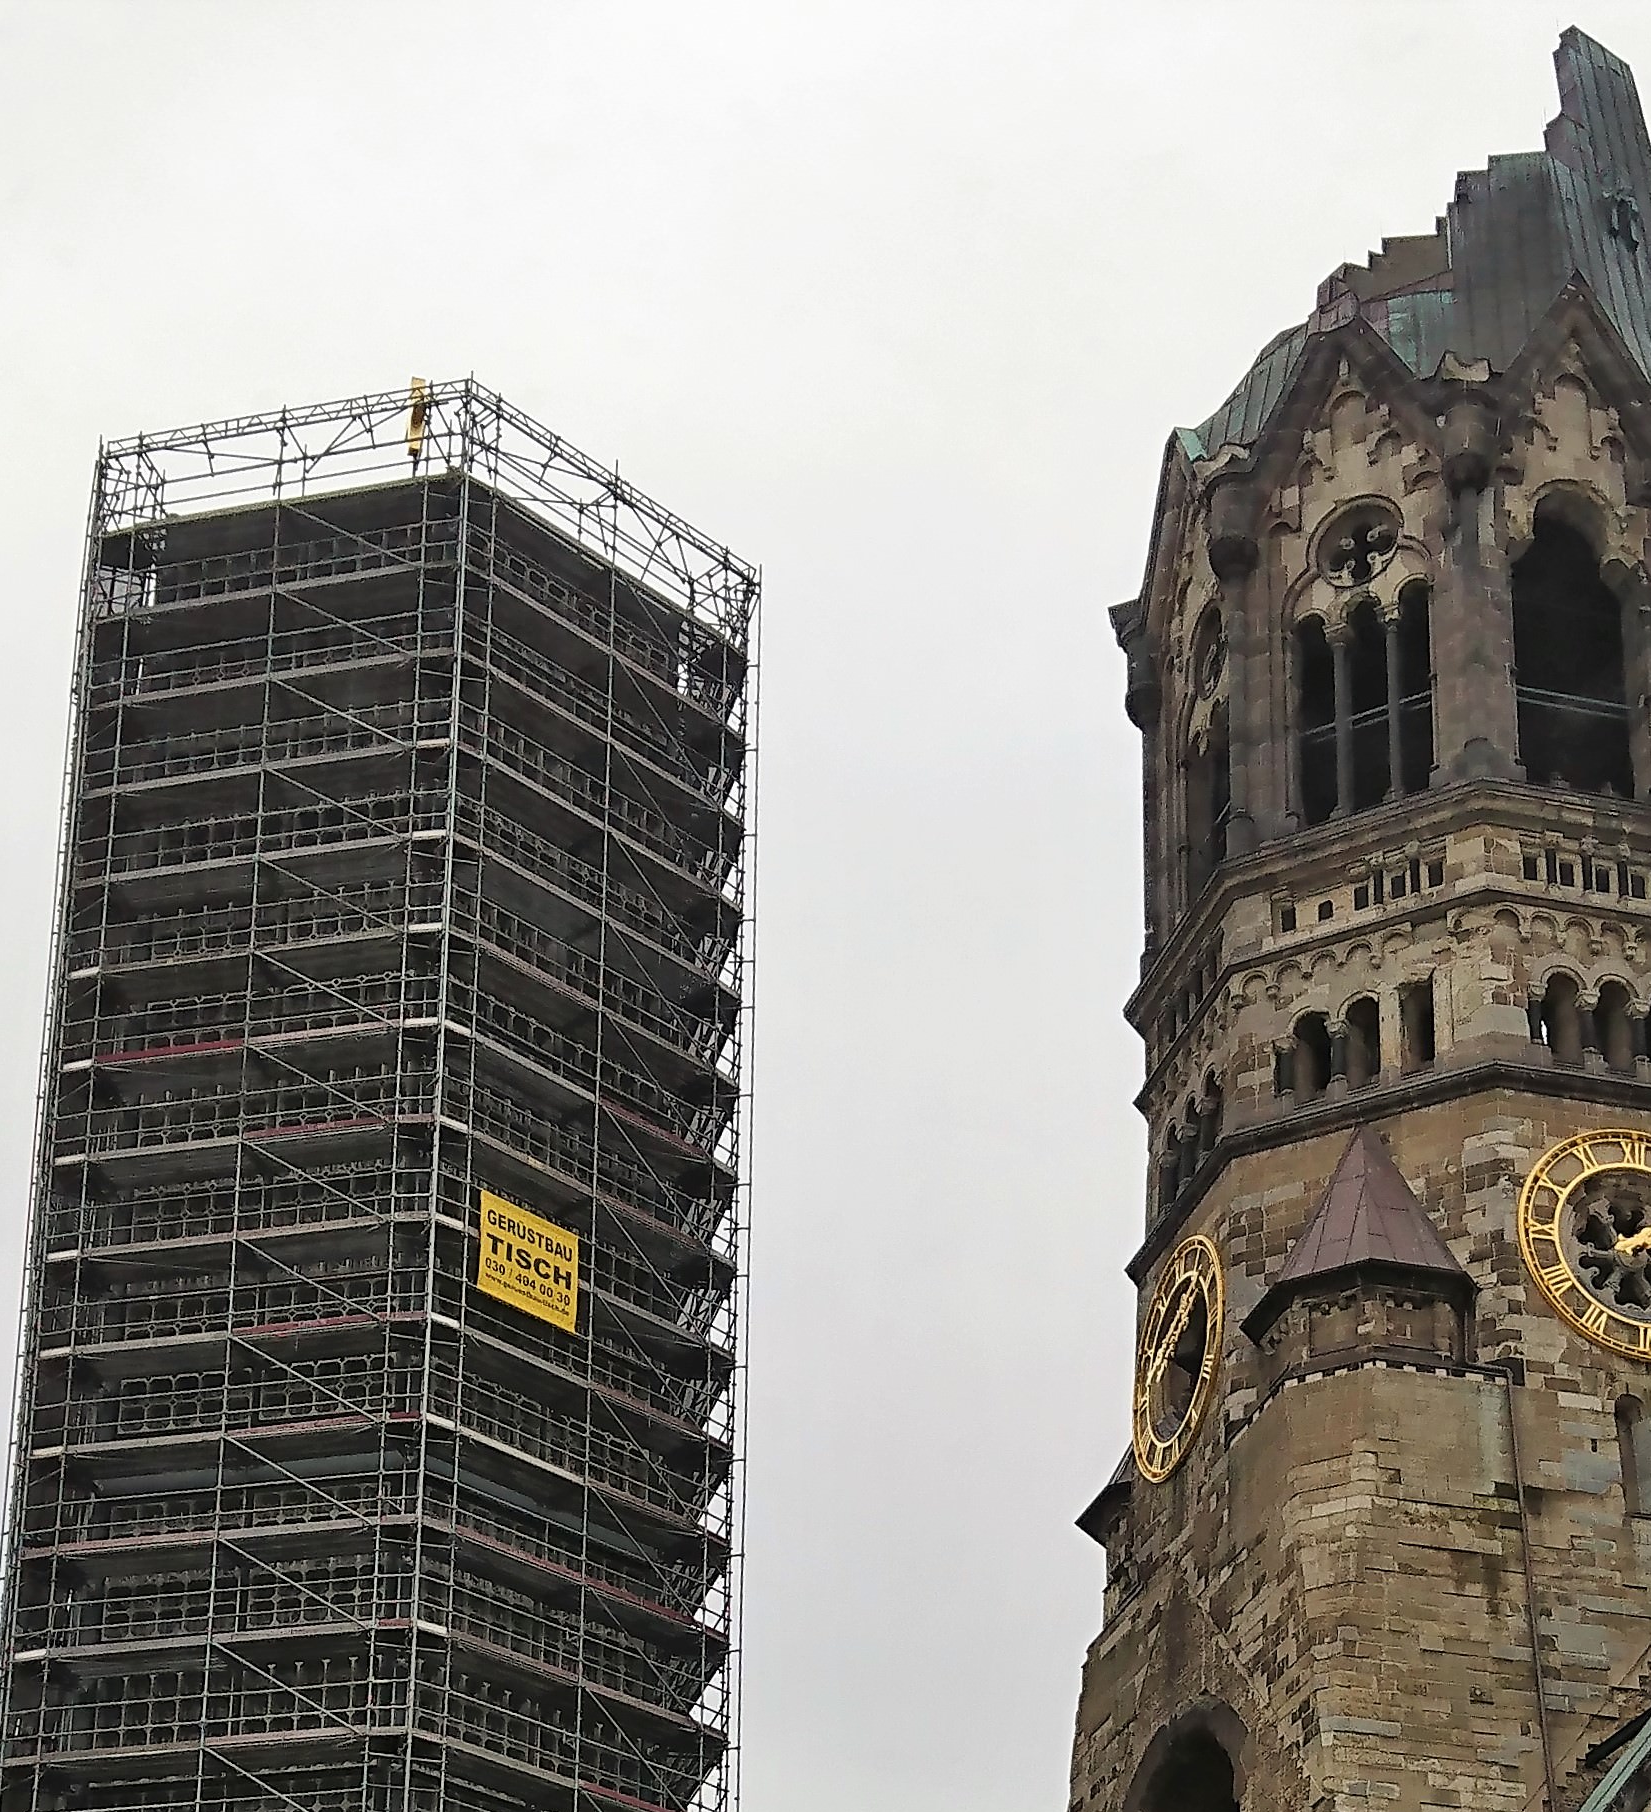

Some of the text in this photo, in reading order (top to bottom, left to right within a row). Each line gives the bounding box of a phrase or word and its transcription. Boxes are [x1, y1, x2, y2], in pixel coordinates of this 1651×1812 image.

[486, 1232, 572, 1291] TISCH
[487, 1209, 573, 1263] GERÜSTBAU
[485, 1257, 506, 1276] 030
[515, 1273, 536, 1290] 404
[539, 1283, 553, 1298] 00
[556, 1291, 571, 1306] 30
